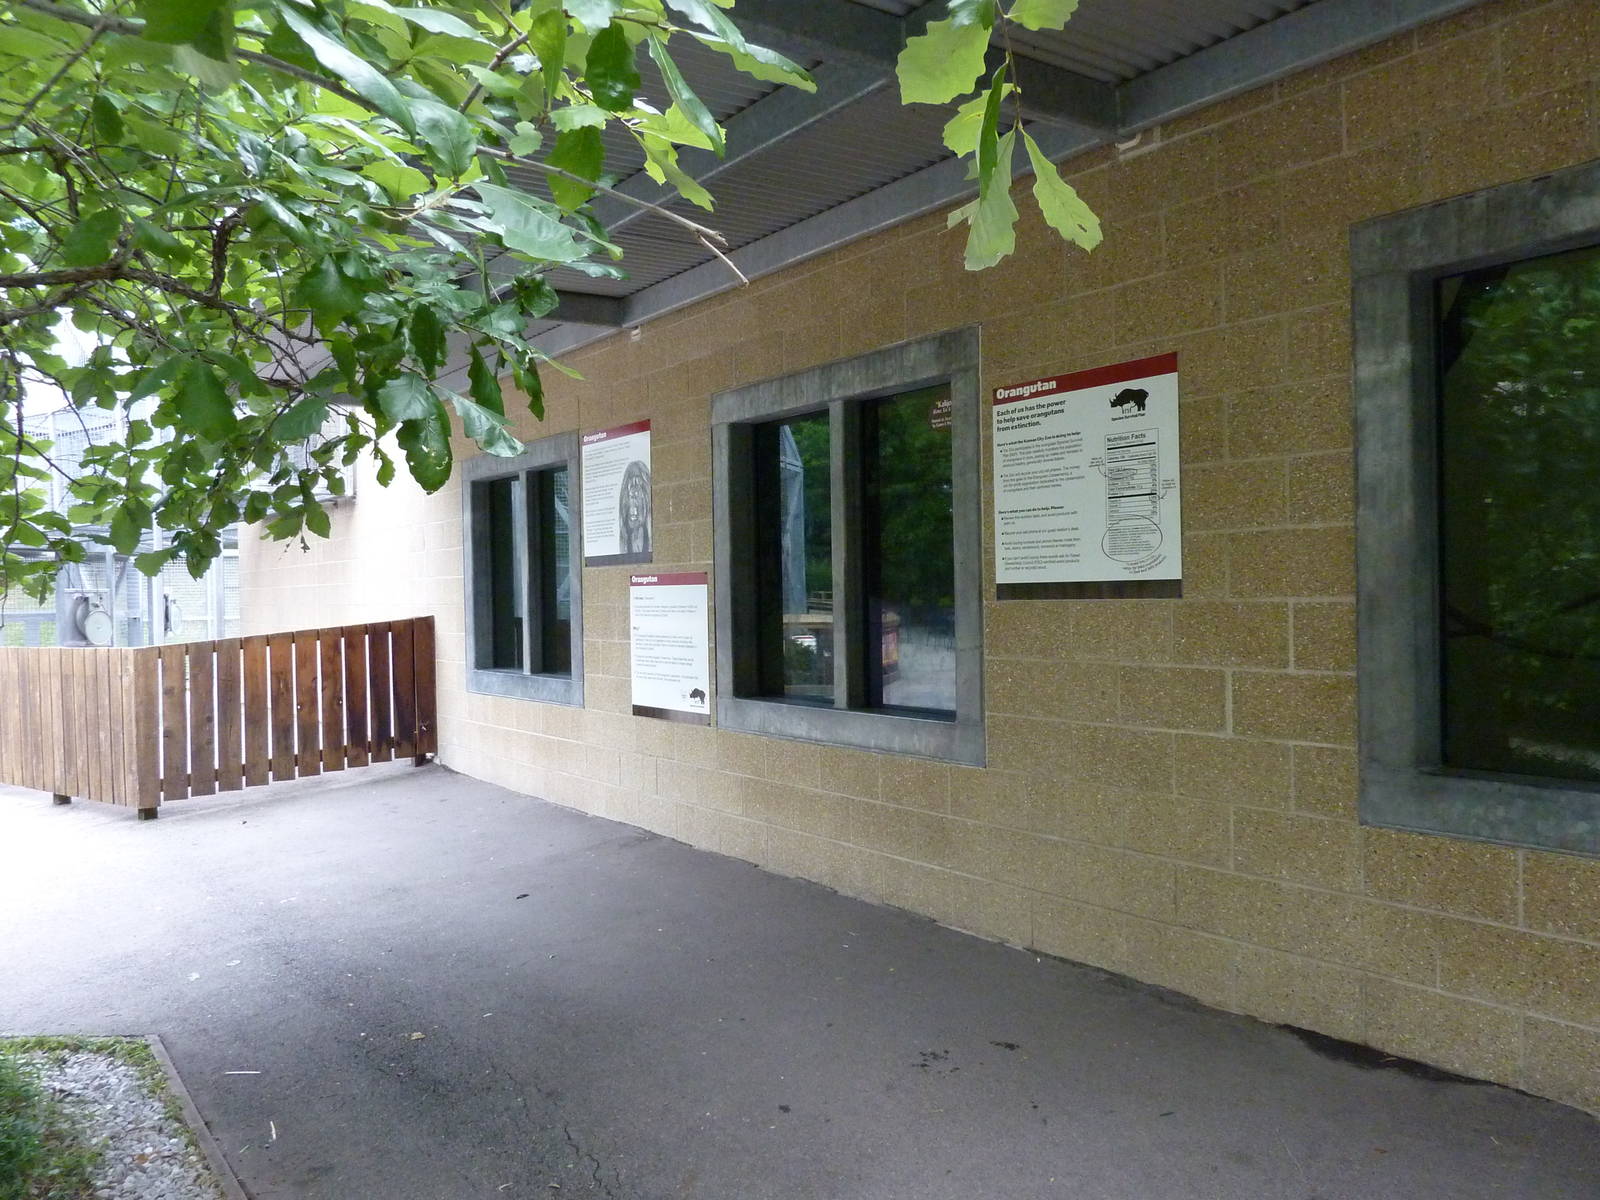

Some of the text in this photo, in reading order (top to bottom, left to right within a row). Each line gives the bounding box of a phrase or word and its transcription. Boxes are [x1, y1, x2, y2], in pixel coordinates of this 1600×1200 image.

[996, 380, 1057, 400] Orangutan
[997, 408, 1010, 416] Each
[1046, 400, 1066, 408] power
[1004, 416, 1016, 424] help
[1031, 408, 1064, 418] orangutans
[997, 420, 1042, 432] from extinction.
[583, 432, 607, 443] Orangutan
[632, 575, 658, 584] Orangutan
